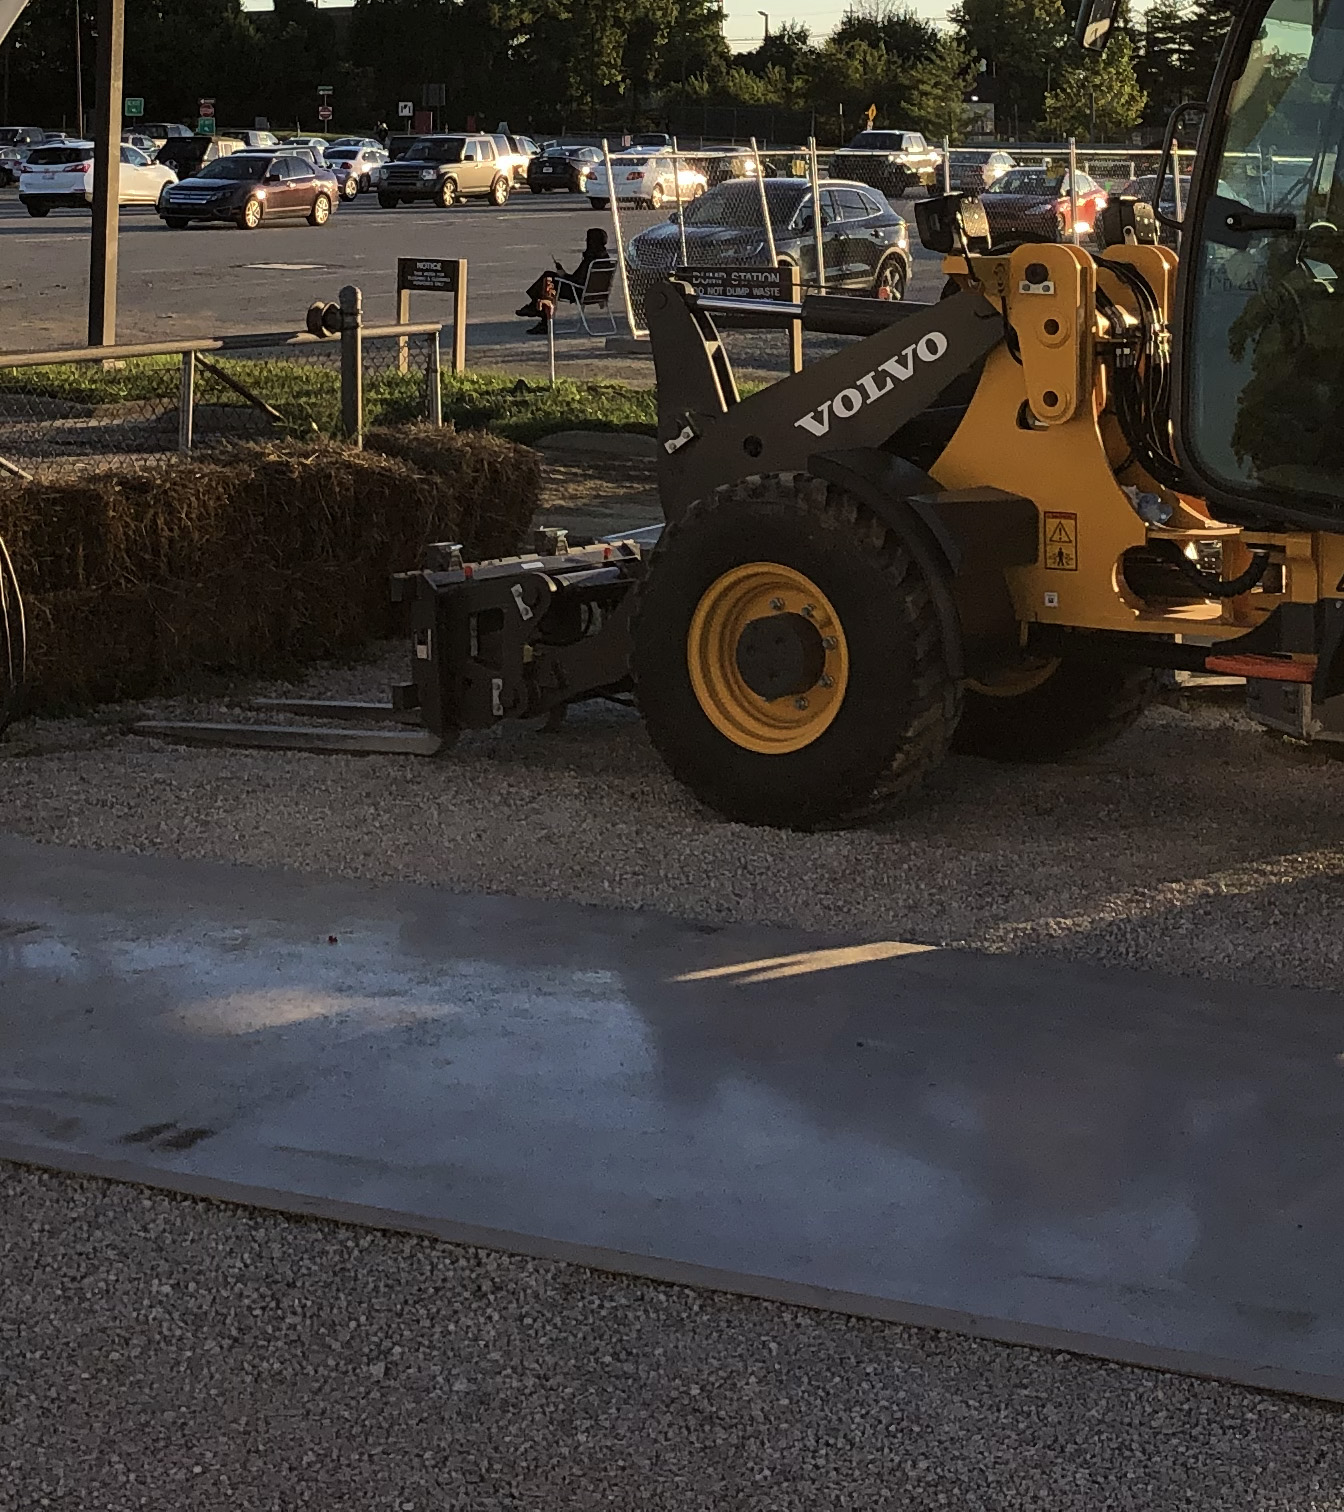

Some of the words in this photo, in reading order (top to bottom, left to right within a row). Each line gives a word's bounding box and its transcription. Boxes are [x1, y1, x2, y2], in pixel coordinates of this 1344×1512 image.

[692, 271, 727, 285] DUMP
[731, 271, 780, 285] STATION
[707, 286, 724, 296] NOT
[726, 286, 750, 296] DUMP
[752, 287, 781, 297] WASTE
[793, 331, 948, 437] VOLVO
